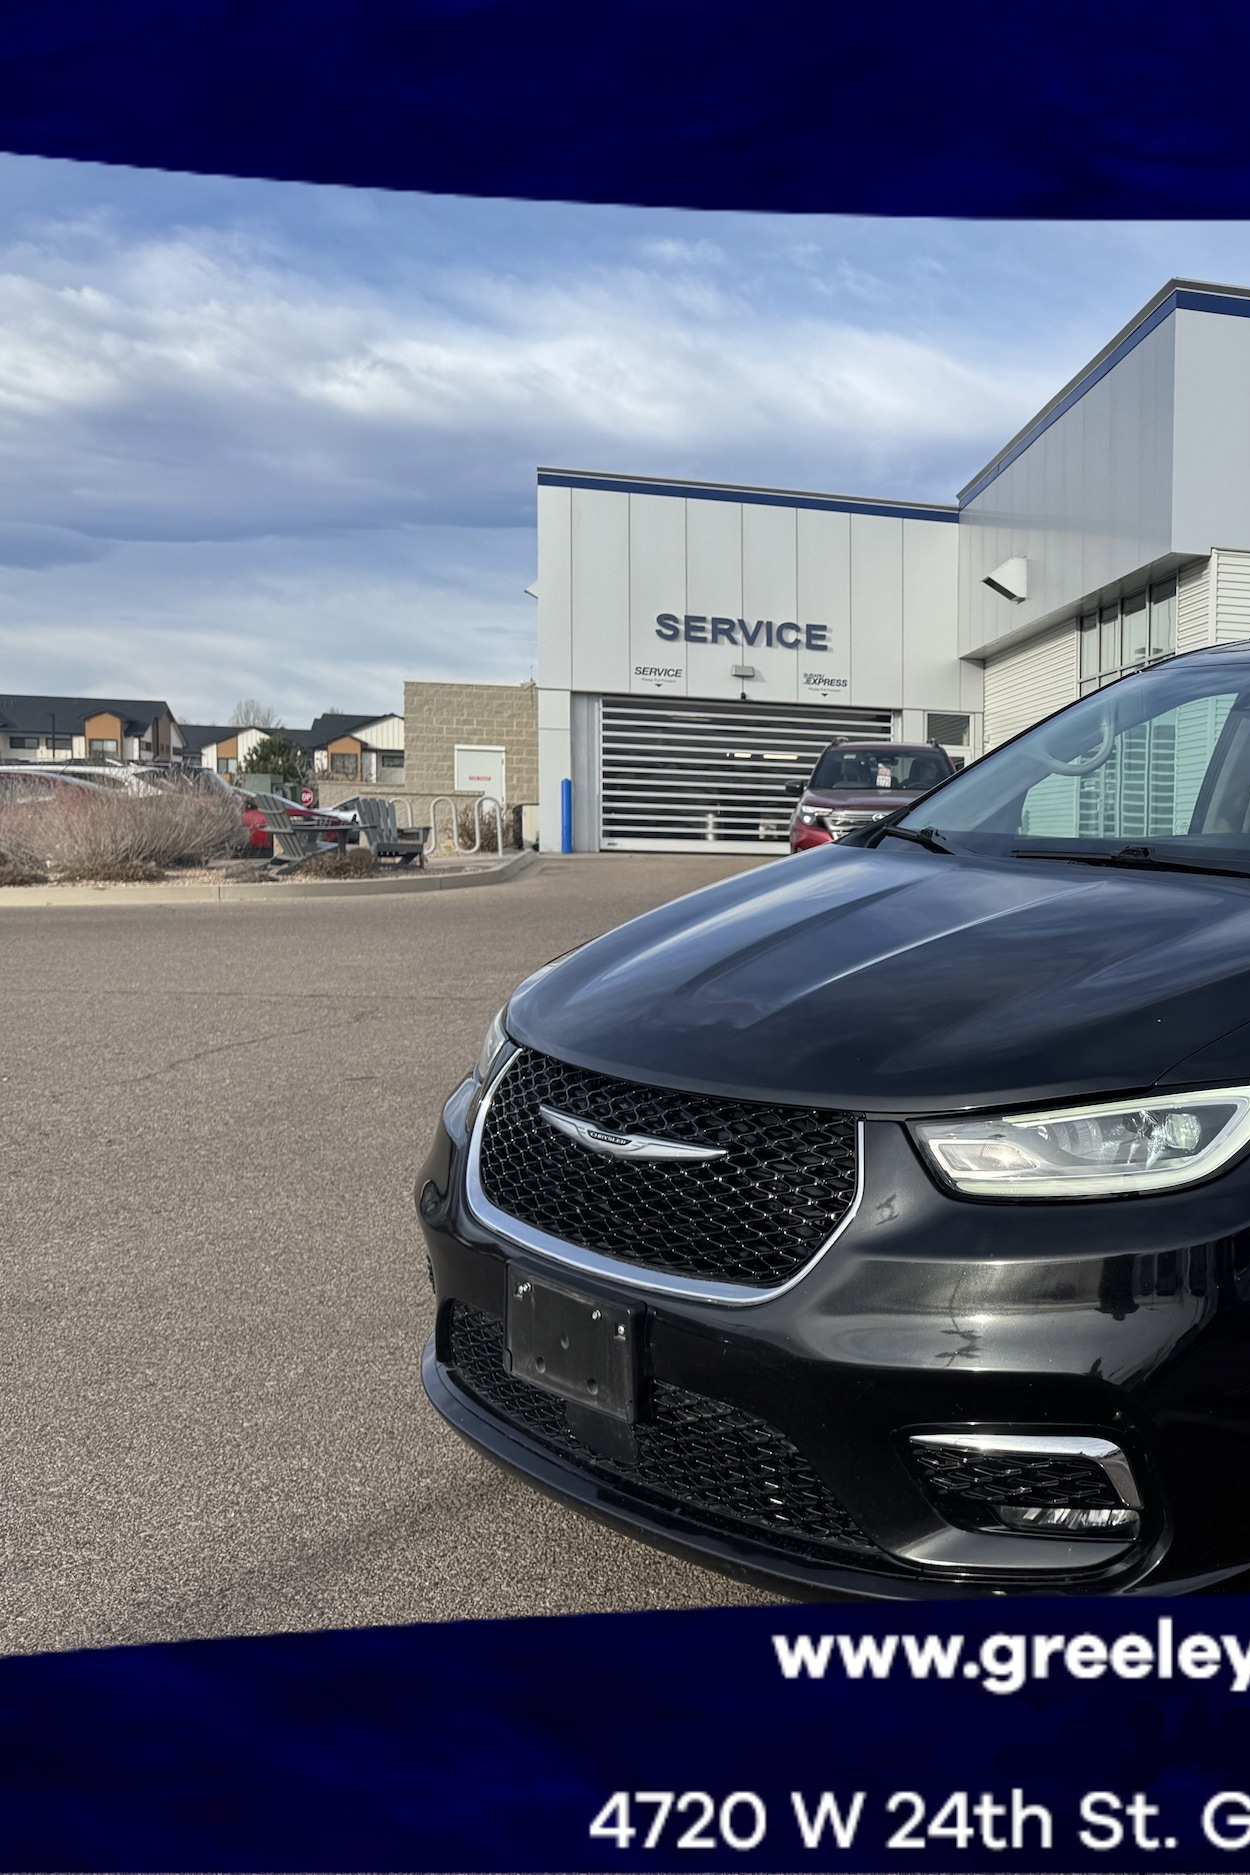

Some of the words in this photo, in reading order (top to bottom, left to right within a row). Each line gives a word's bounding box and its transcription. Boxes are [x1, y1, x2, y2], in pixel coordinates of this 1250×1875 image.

[655, 612, 829, 652] SERVICE
[634, 665, 683, 678] SERVICE
[804, 676, 848, 688] EXPRESS
[590, 1131, 627, 1145] CHRYSLER
